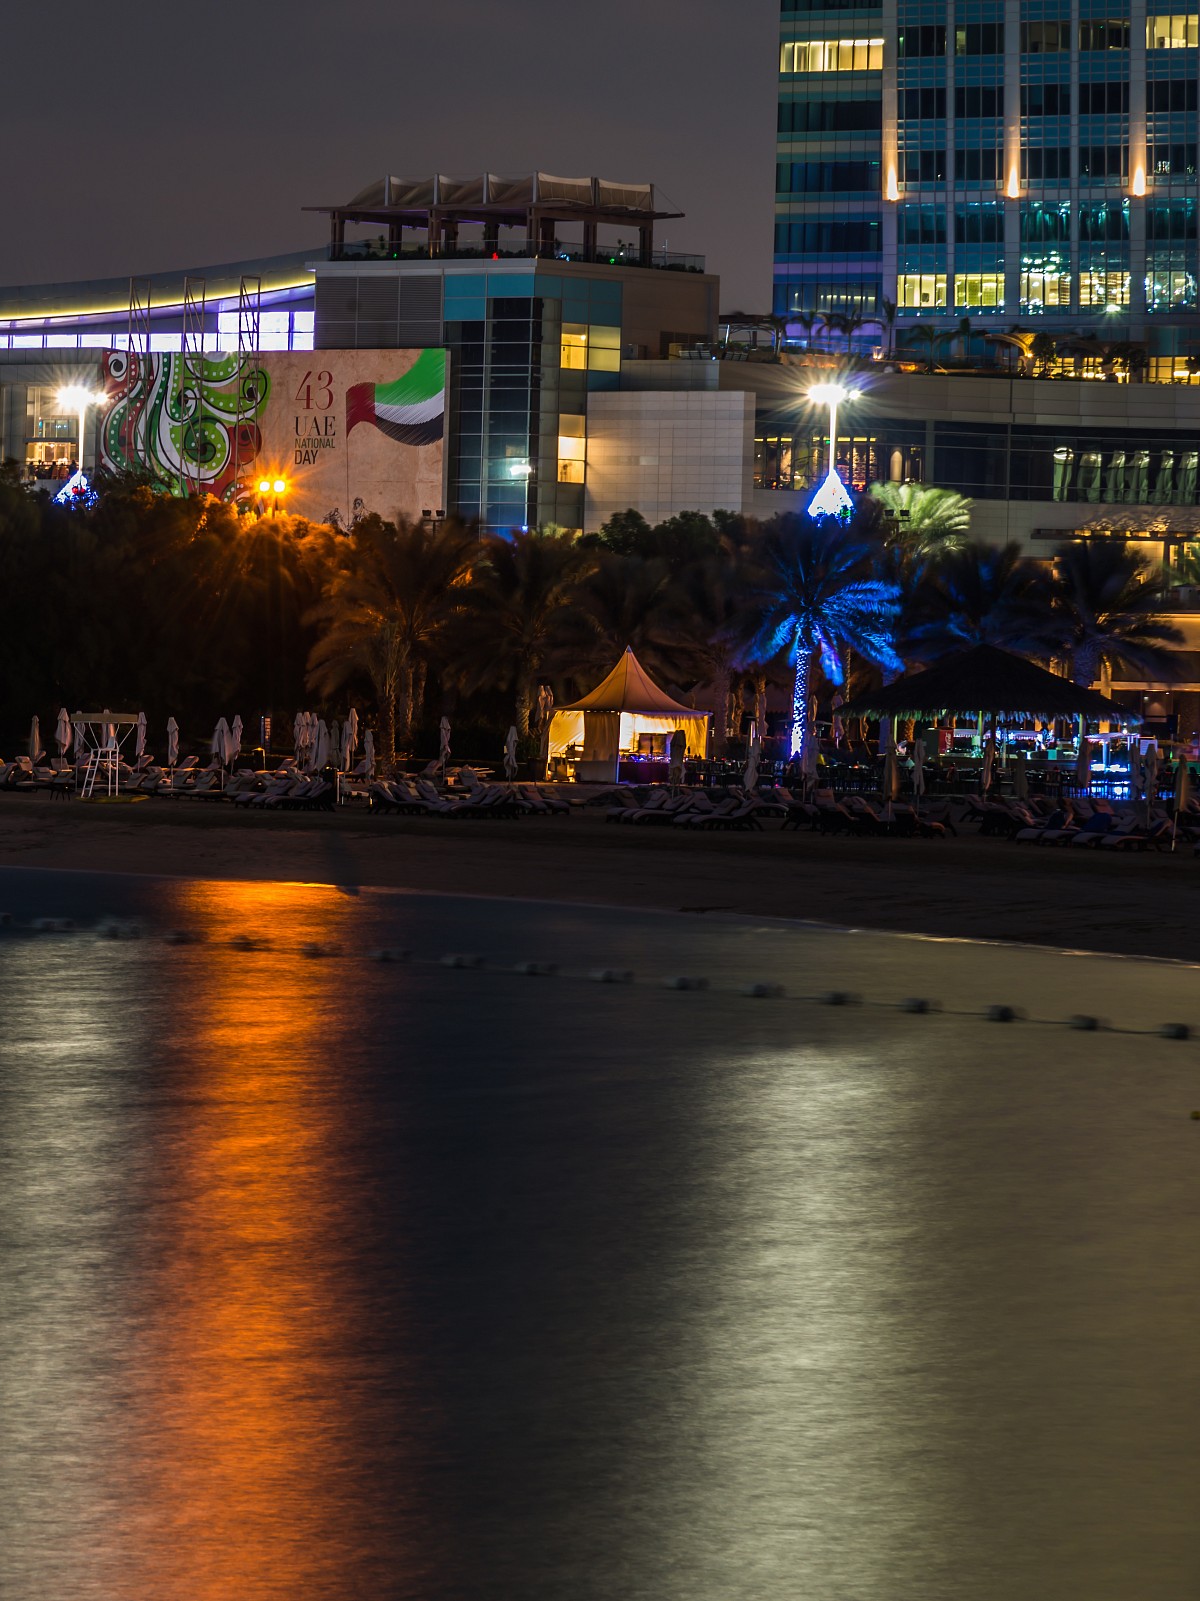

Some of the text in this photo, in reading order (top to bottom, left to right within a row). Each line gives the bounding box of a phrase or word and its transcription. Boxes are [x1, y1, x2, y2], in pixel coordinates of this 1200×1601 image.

[295, 370, 333, 410] 43
[294, 415, 336, 437] UAE
[294, 437, 336, 449] NATIONAL
[294, 449, 319, 465] DAY
